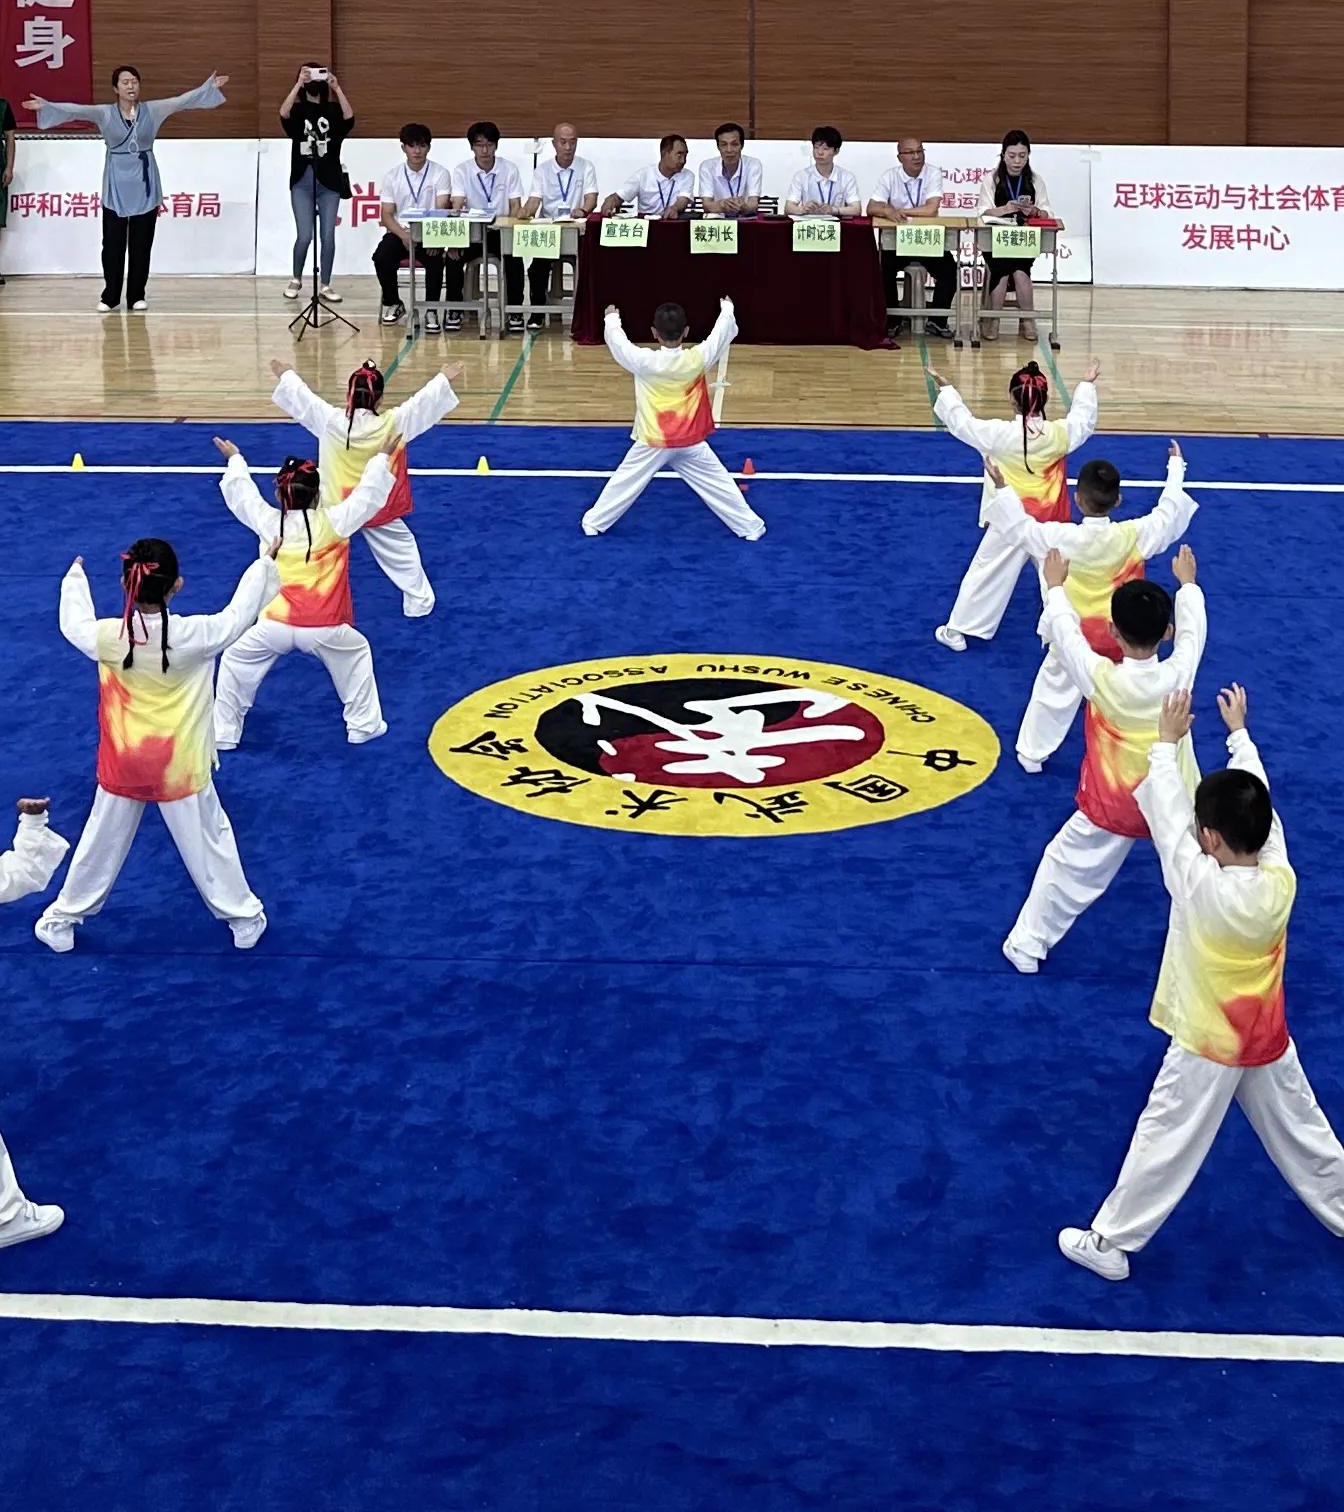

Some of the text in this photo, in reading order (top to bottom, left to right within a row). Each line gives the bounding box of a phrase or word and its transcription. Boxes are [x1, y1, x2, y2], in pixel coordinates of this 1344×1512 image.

[1182, 224, 1290, 251] 发展中心
[483, 663, 937, 724] CHINESE WUSHU ASSOCIATION
